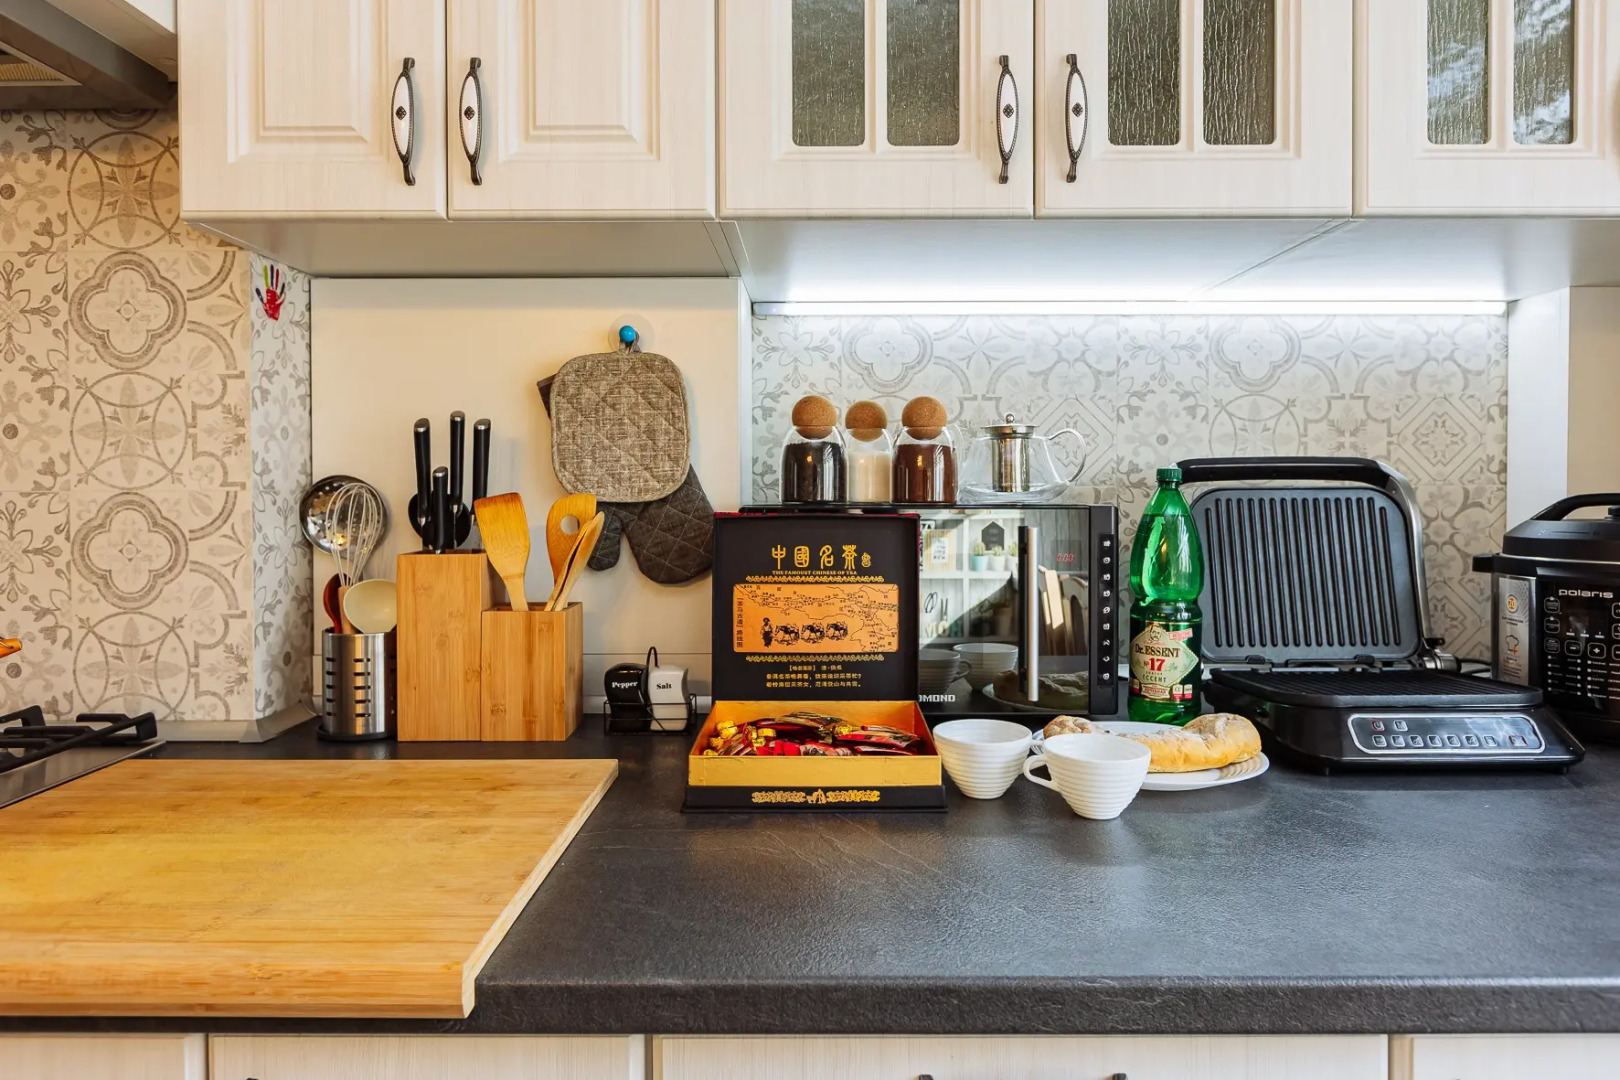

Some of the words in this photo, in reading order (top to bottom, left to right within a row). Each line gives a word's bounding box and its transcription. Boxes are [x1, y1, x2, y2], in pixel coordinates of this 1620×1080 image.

[1559, 589, 1614, 599] polaris
[611, 681, 638, 689] Pepper
[656, 682, 672, 690] Salt
